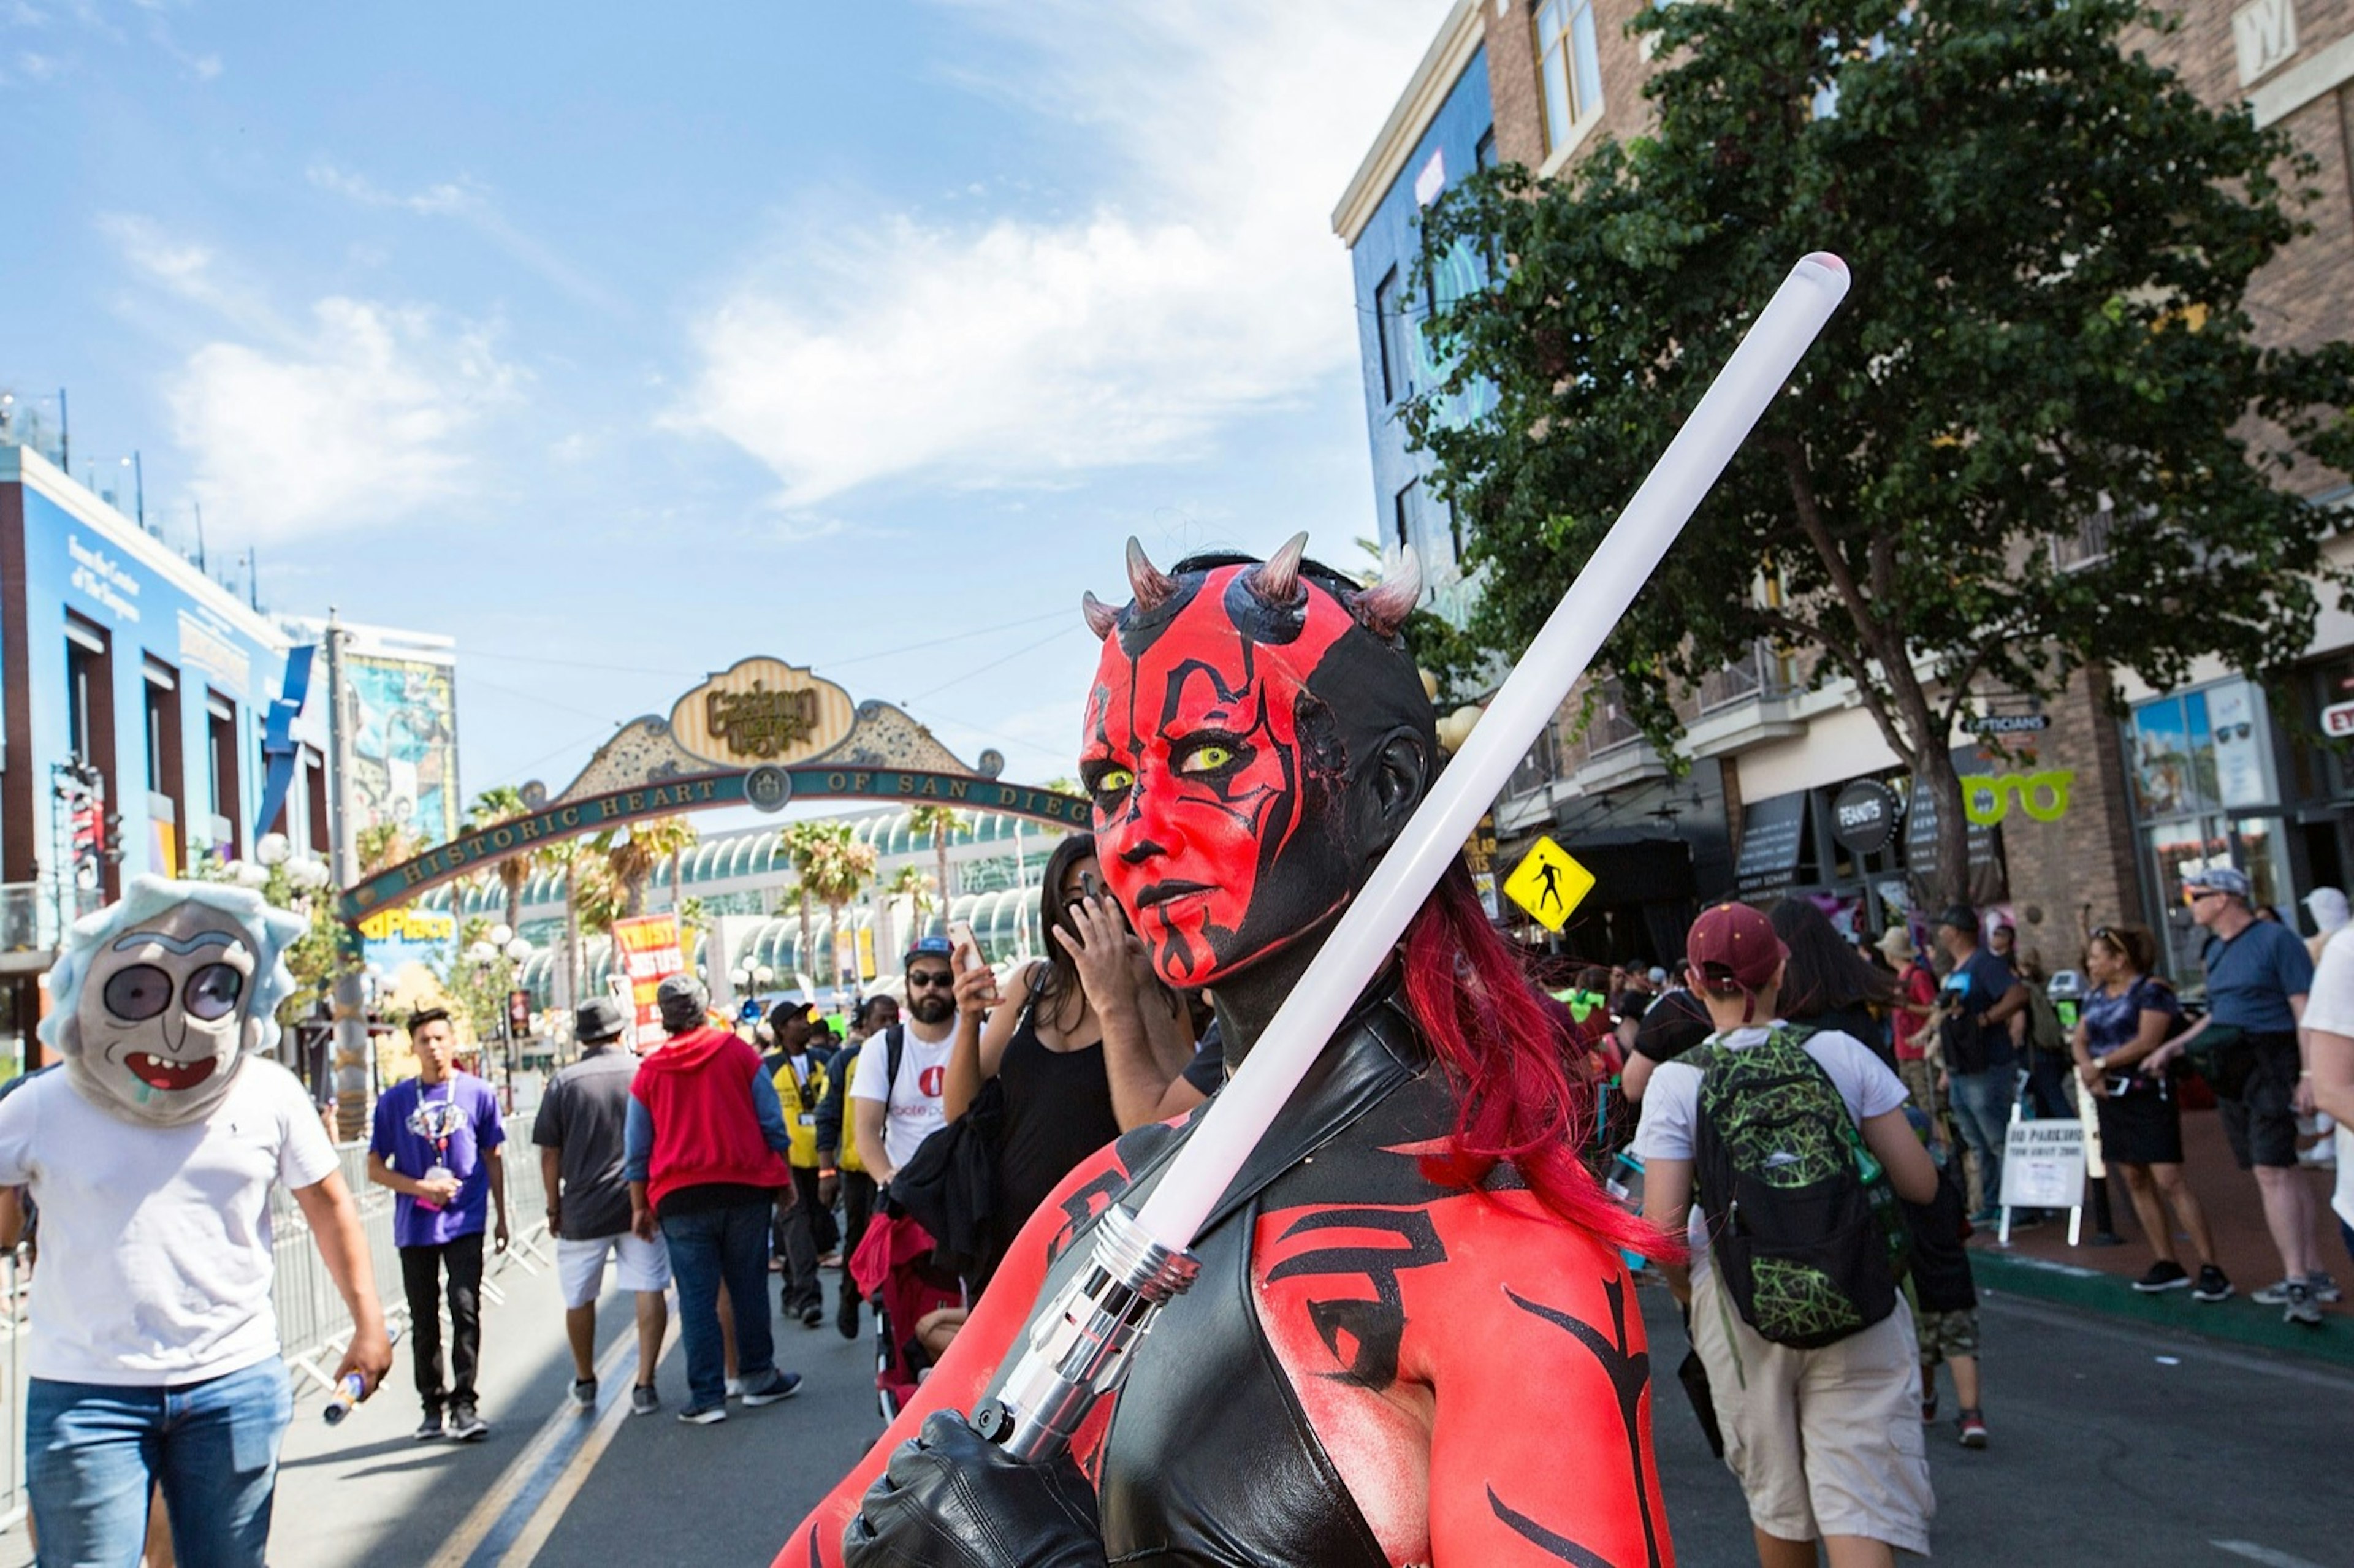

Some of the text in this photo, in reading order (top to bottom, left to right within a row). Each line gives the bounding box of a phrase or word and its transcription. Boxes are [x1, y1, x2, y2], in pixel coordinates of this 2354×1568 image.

[403, 772, 1089, 885] HISTORIC HEART OF SAN DIEG
